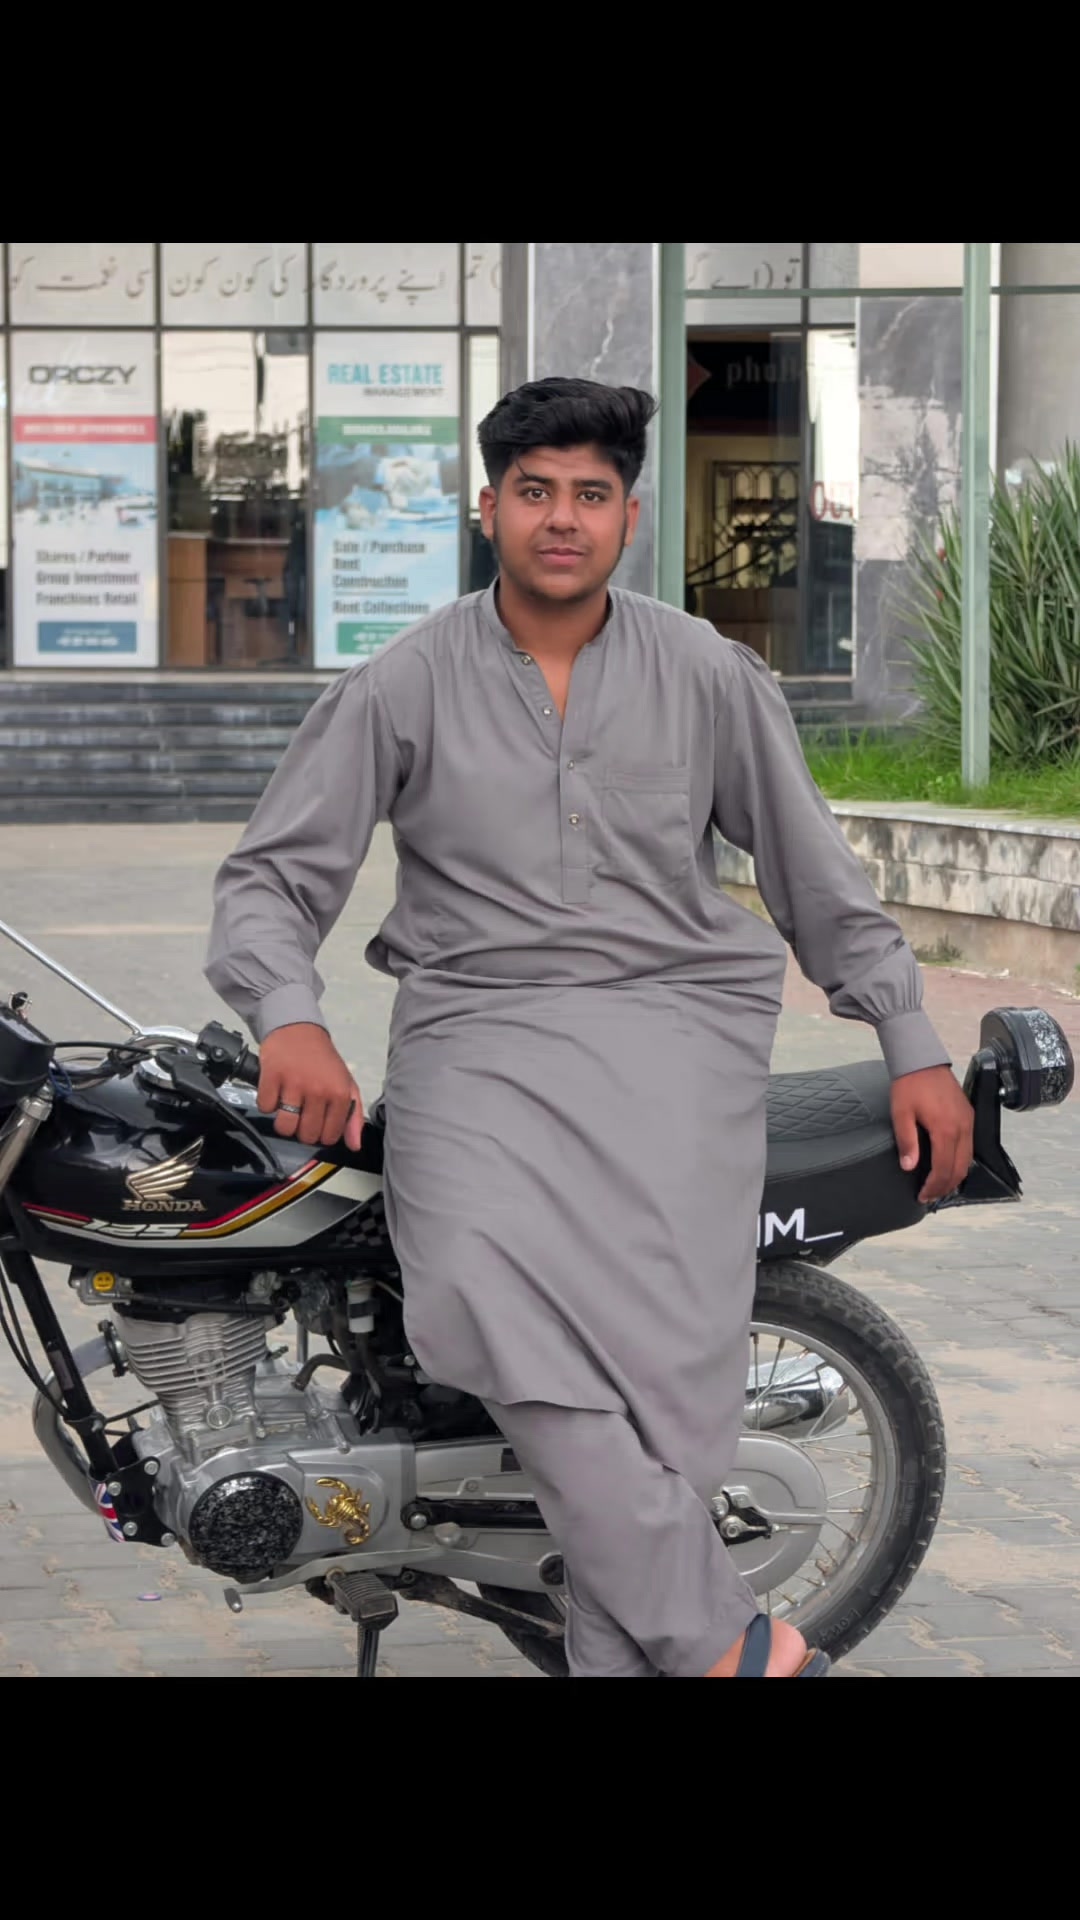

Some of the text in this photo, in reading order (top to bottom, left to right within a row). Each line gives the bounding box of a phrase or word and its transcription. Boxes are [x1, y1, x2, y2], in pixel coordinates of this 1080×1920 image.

[29, 365, 137, 385] ORCZY
[327, 364, 443, 385] REAL ESTATE
[333, 557, 360, 571] Rent
[333, 574, 408, 589] Construction
[333, 600, 430, 615] Rent Collections
[122, 1199, 207, 1212] HONDA
[82, 1218, 190, 1239] 125
